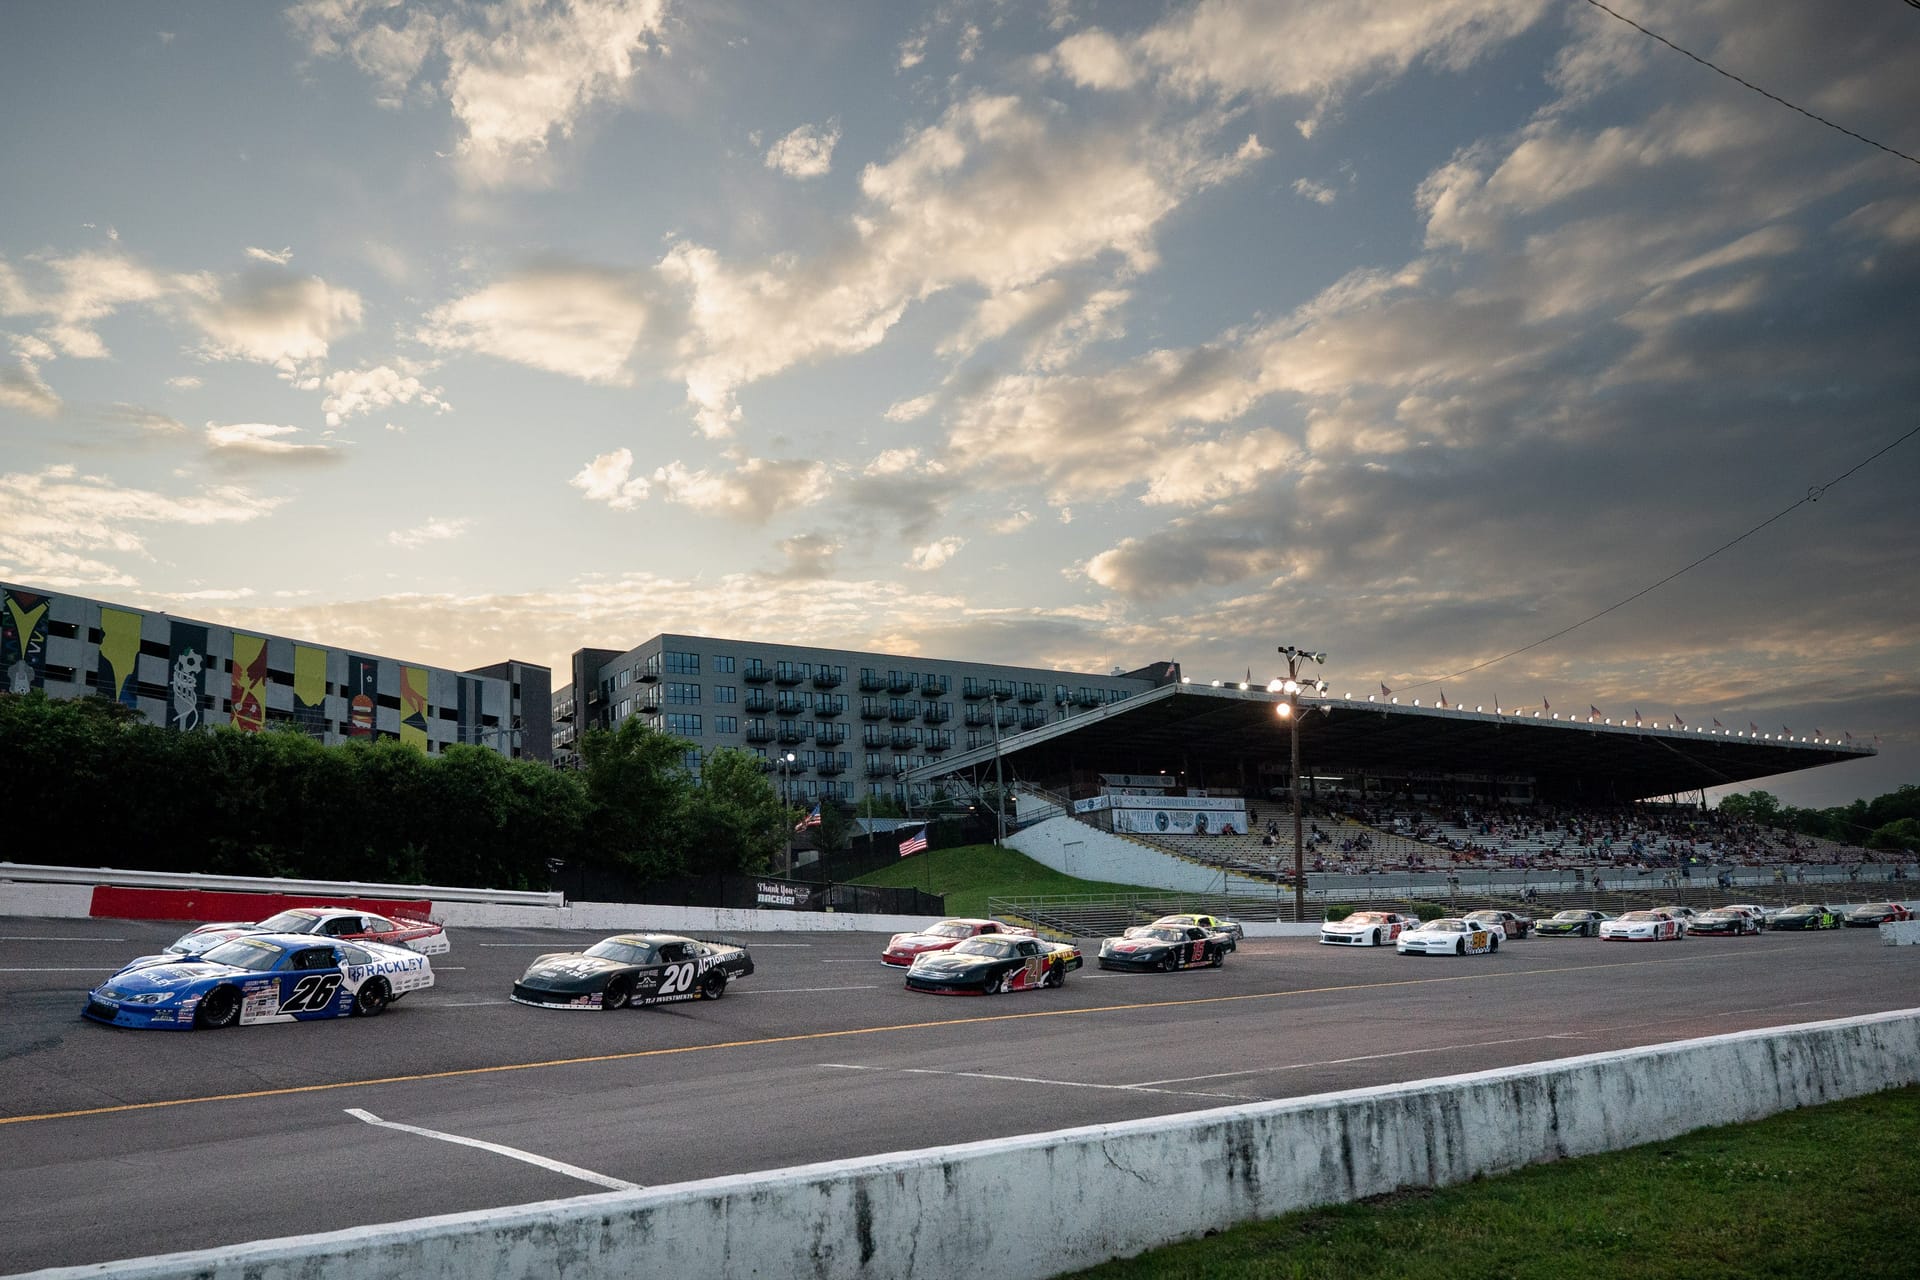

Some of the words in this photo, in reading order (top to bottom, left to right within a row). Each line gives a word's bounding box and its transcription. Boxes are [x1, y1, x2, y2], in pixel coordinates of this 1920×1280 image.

[1472, 931, 1488, 949] 98
[366, 957, 423, 976] RACKLEY
[658, 963, 695, 994] 20
[697, 956, 725, 978] ACTION
[1024, 956, 1043, 986] 21
[278, 974, 344, 1014] 26
